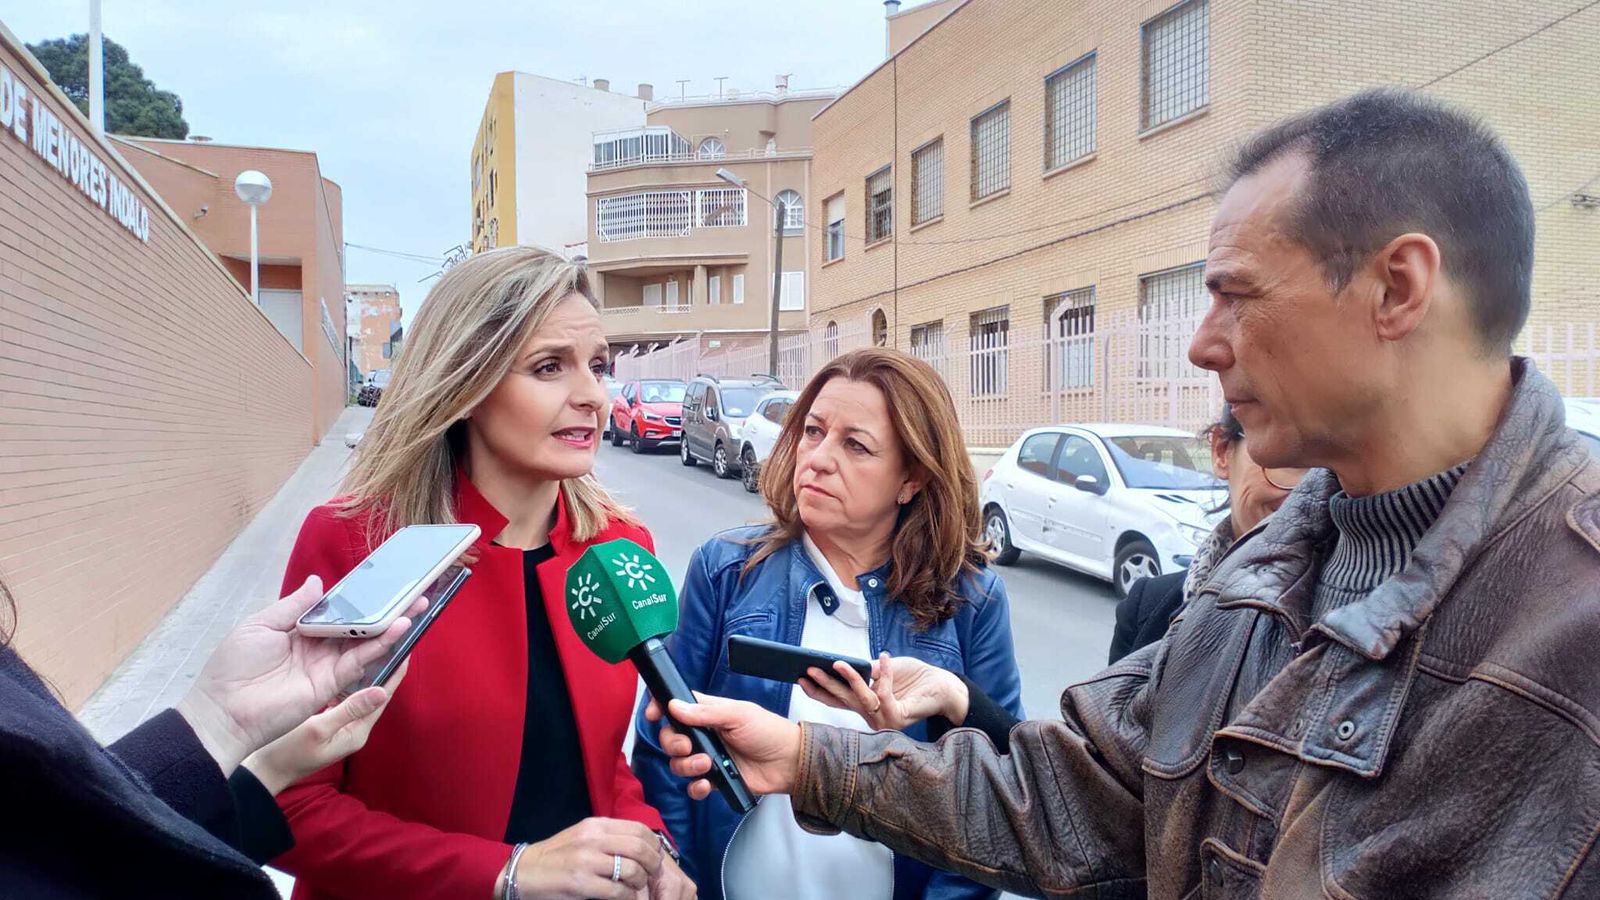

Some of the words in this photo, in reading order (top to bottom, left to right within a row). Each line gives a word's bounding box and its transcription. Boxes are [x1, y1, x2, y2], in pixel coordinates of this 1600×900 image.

[0, 64, 27, 142] DE
[32, 97, 107, 208] MENORES
[109, 173, 149, 242] INDALO
